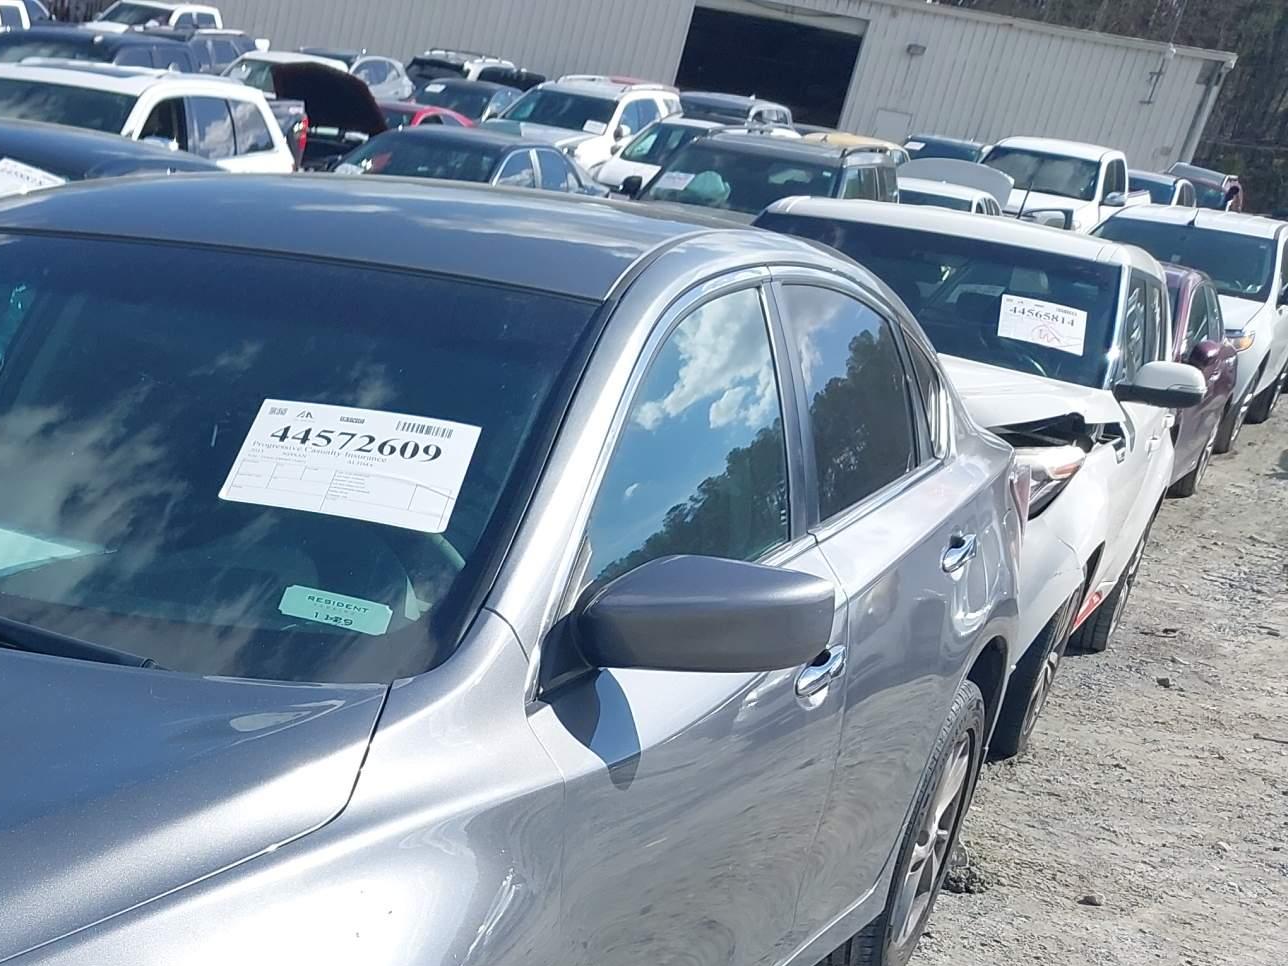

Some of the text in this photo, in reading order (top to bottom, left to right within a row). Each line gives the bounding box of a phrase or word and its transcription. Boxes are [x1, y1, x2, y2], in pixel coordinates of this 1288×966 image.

[1009, 306, 1075, 327] 44565814
[252, 440, 304, 453] Progressive
[344, 451, 388, 464] Insurance
[270, 425, 443, 463] 44572609
[307, 595, 369, 613] RESIDENT
